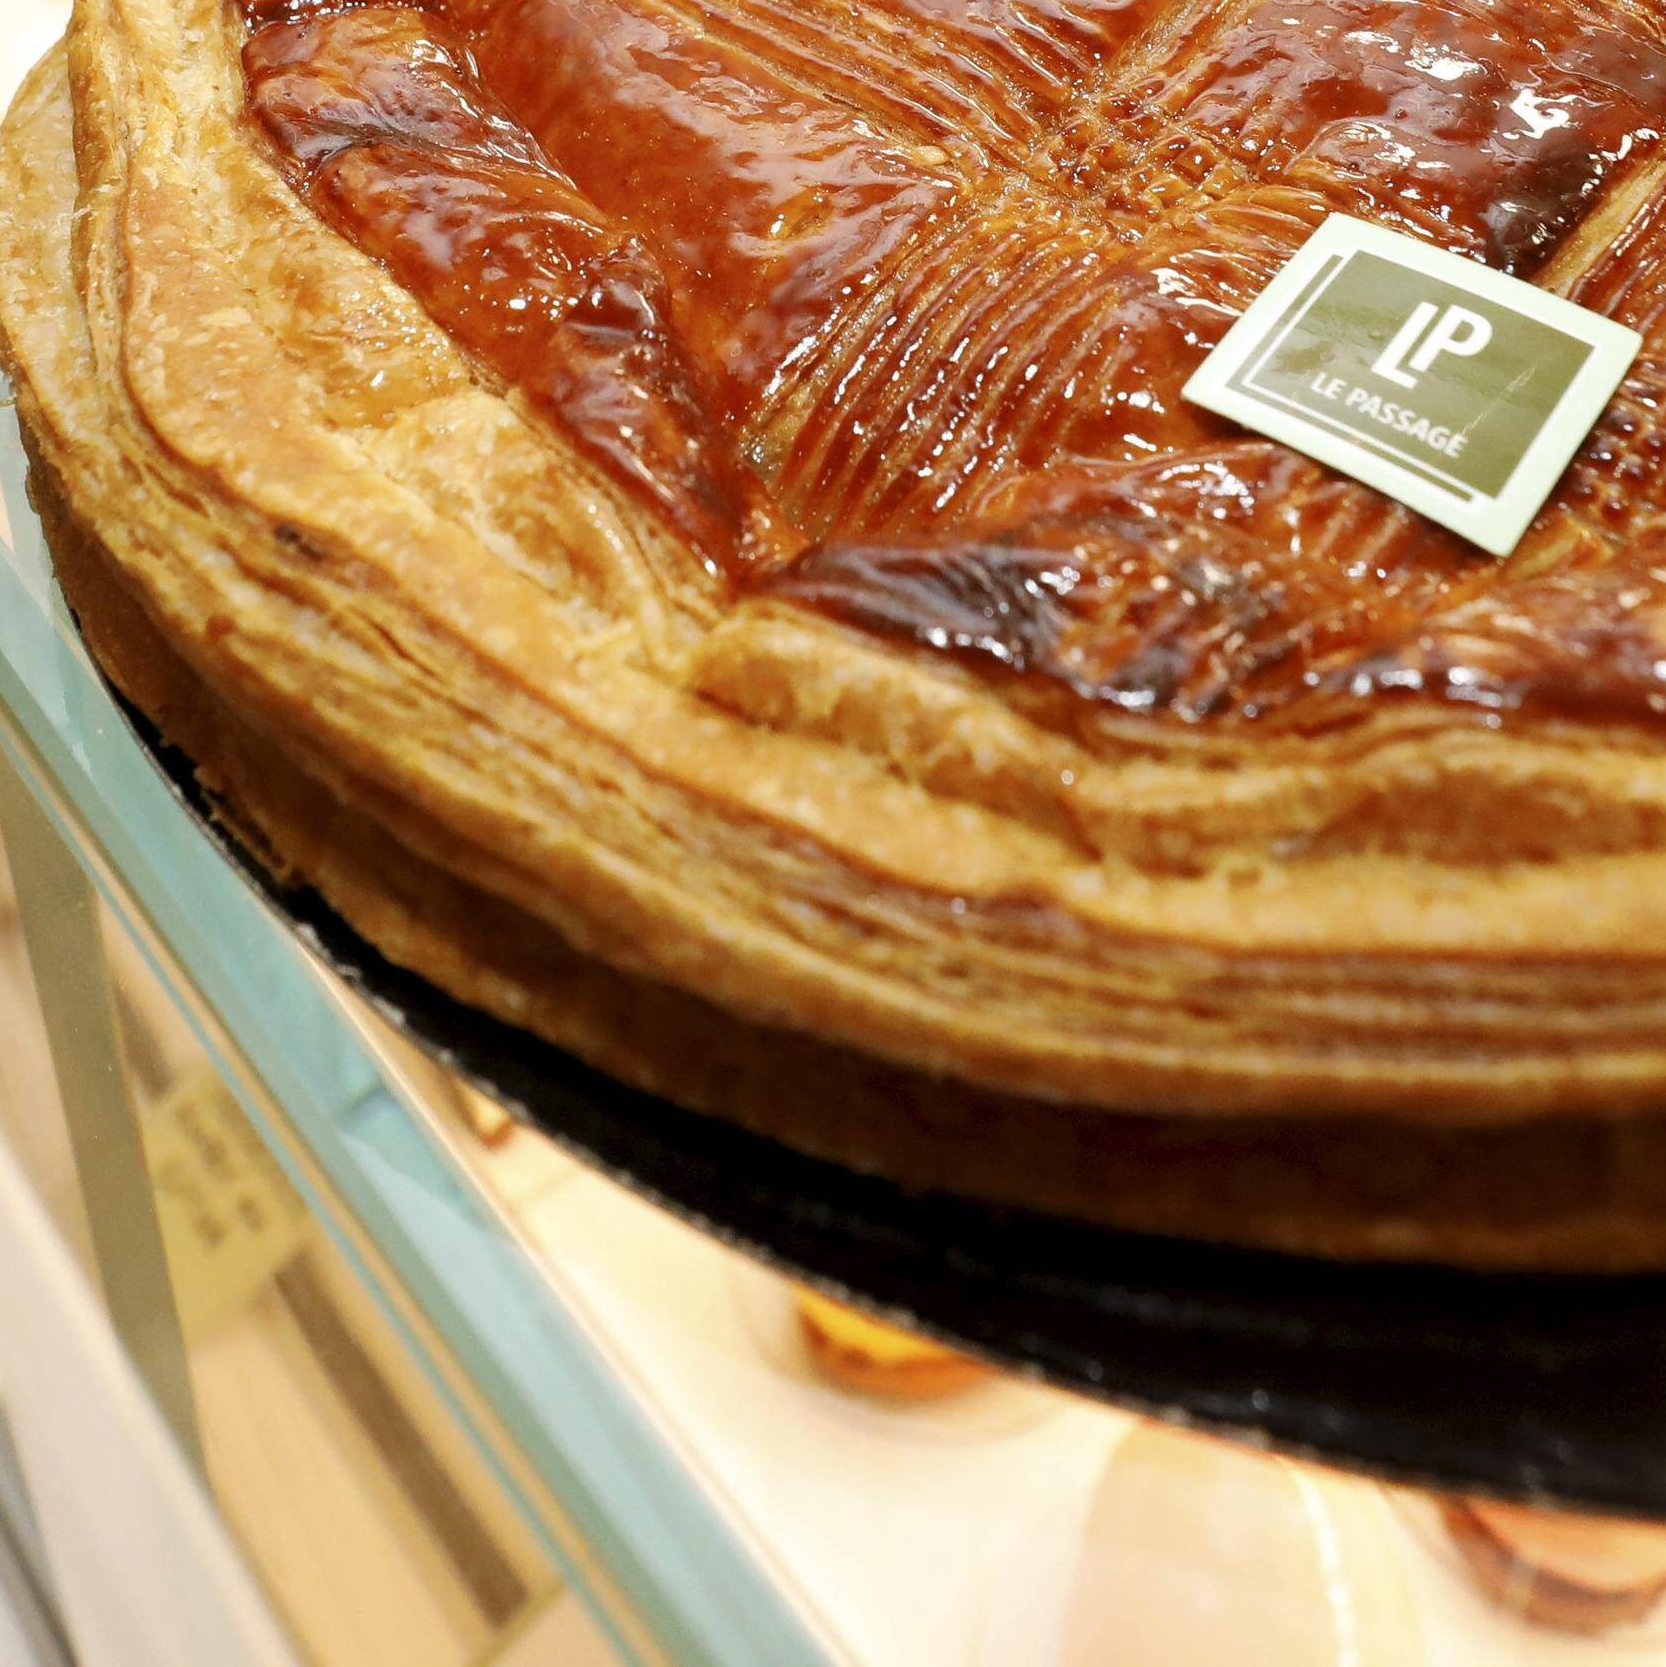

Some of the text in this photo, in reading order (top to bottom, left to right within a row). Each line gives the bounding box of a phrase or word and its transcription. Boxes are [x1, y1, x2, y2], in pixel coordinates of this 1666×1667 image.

[1371, 301, 1493, 389] LP
[1311, 372, 1469, 458] LE PASSAGE
